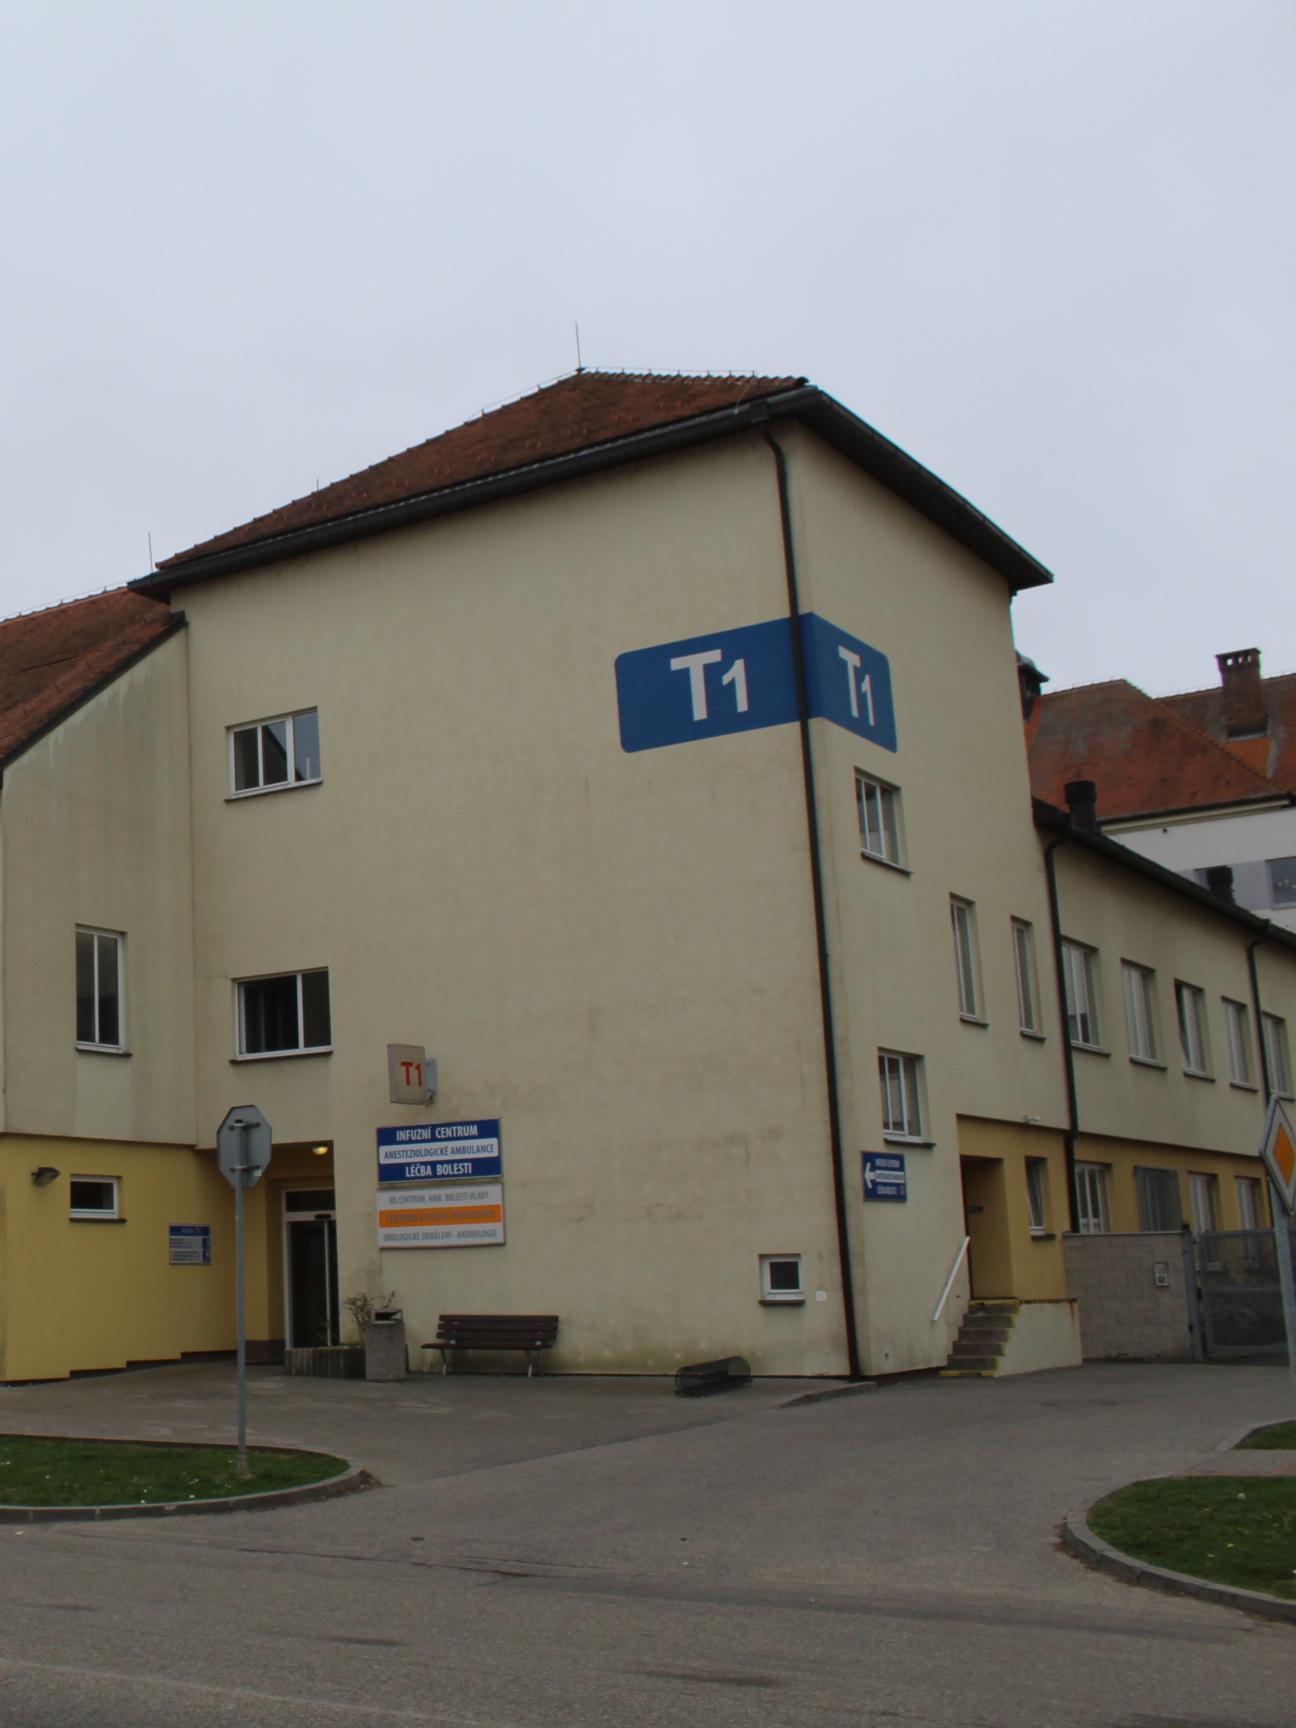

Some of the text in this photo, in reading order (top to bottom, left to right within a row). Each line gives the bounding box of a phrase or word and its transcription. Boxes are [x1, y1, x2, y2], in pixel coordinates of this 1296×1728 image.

[670, 649, 748, 722] T1
[838, 645, 875, 727] T1
[400, 1061, 422, 1087] T1
[396, 1124, 478, 1142] INFUZNÍ CENTRUM
[450, 1143, 495, 1156] AMBULANCE
[406, 1162, 472, 1178] LÉČBA BOLESTI
